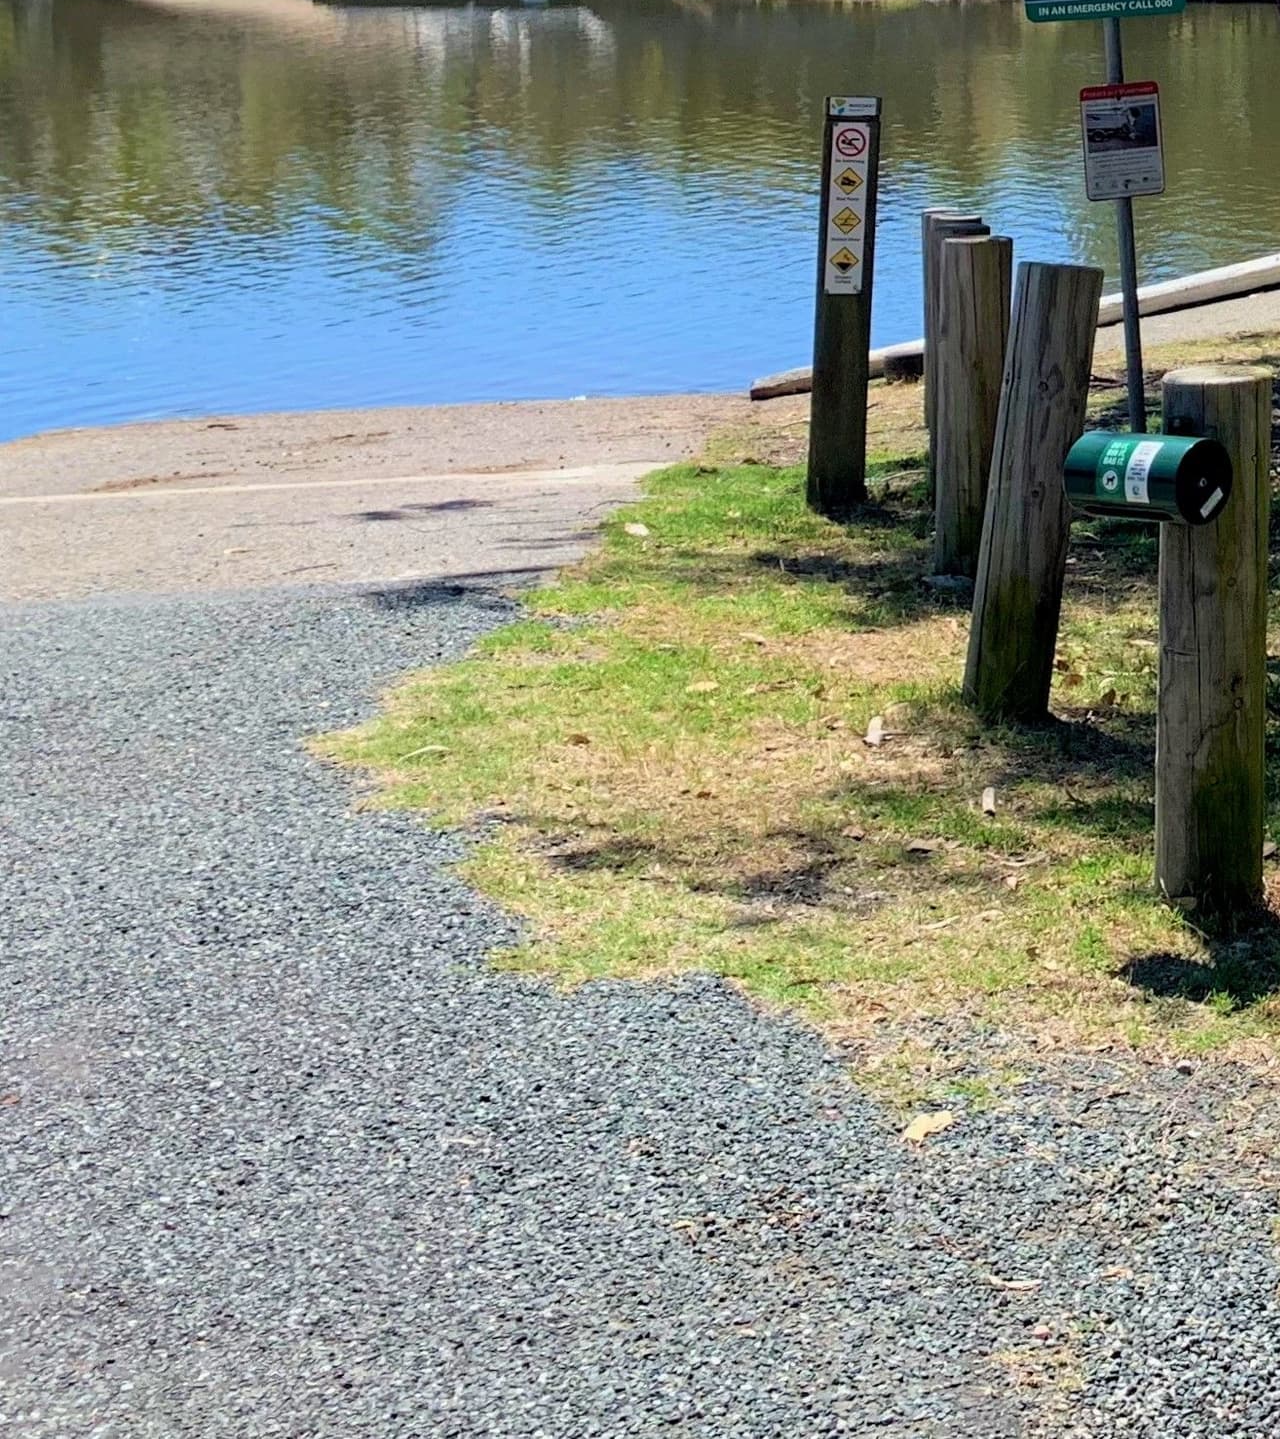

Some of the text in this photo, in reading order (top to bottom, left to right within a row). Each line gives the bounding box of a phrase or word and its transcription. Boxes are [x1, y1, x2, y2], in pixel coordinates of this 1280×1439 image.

[1038, 0, 1173, 16] IN AN EMERGENCY CALL 000
